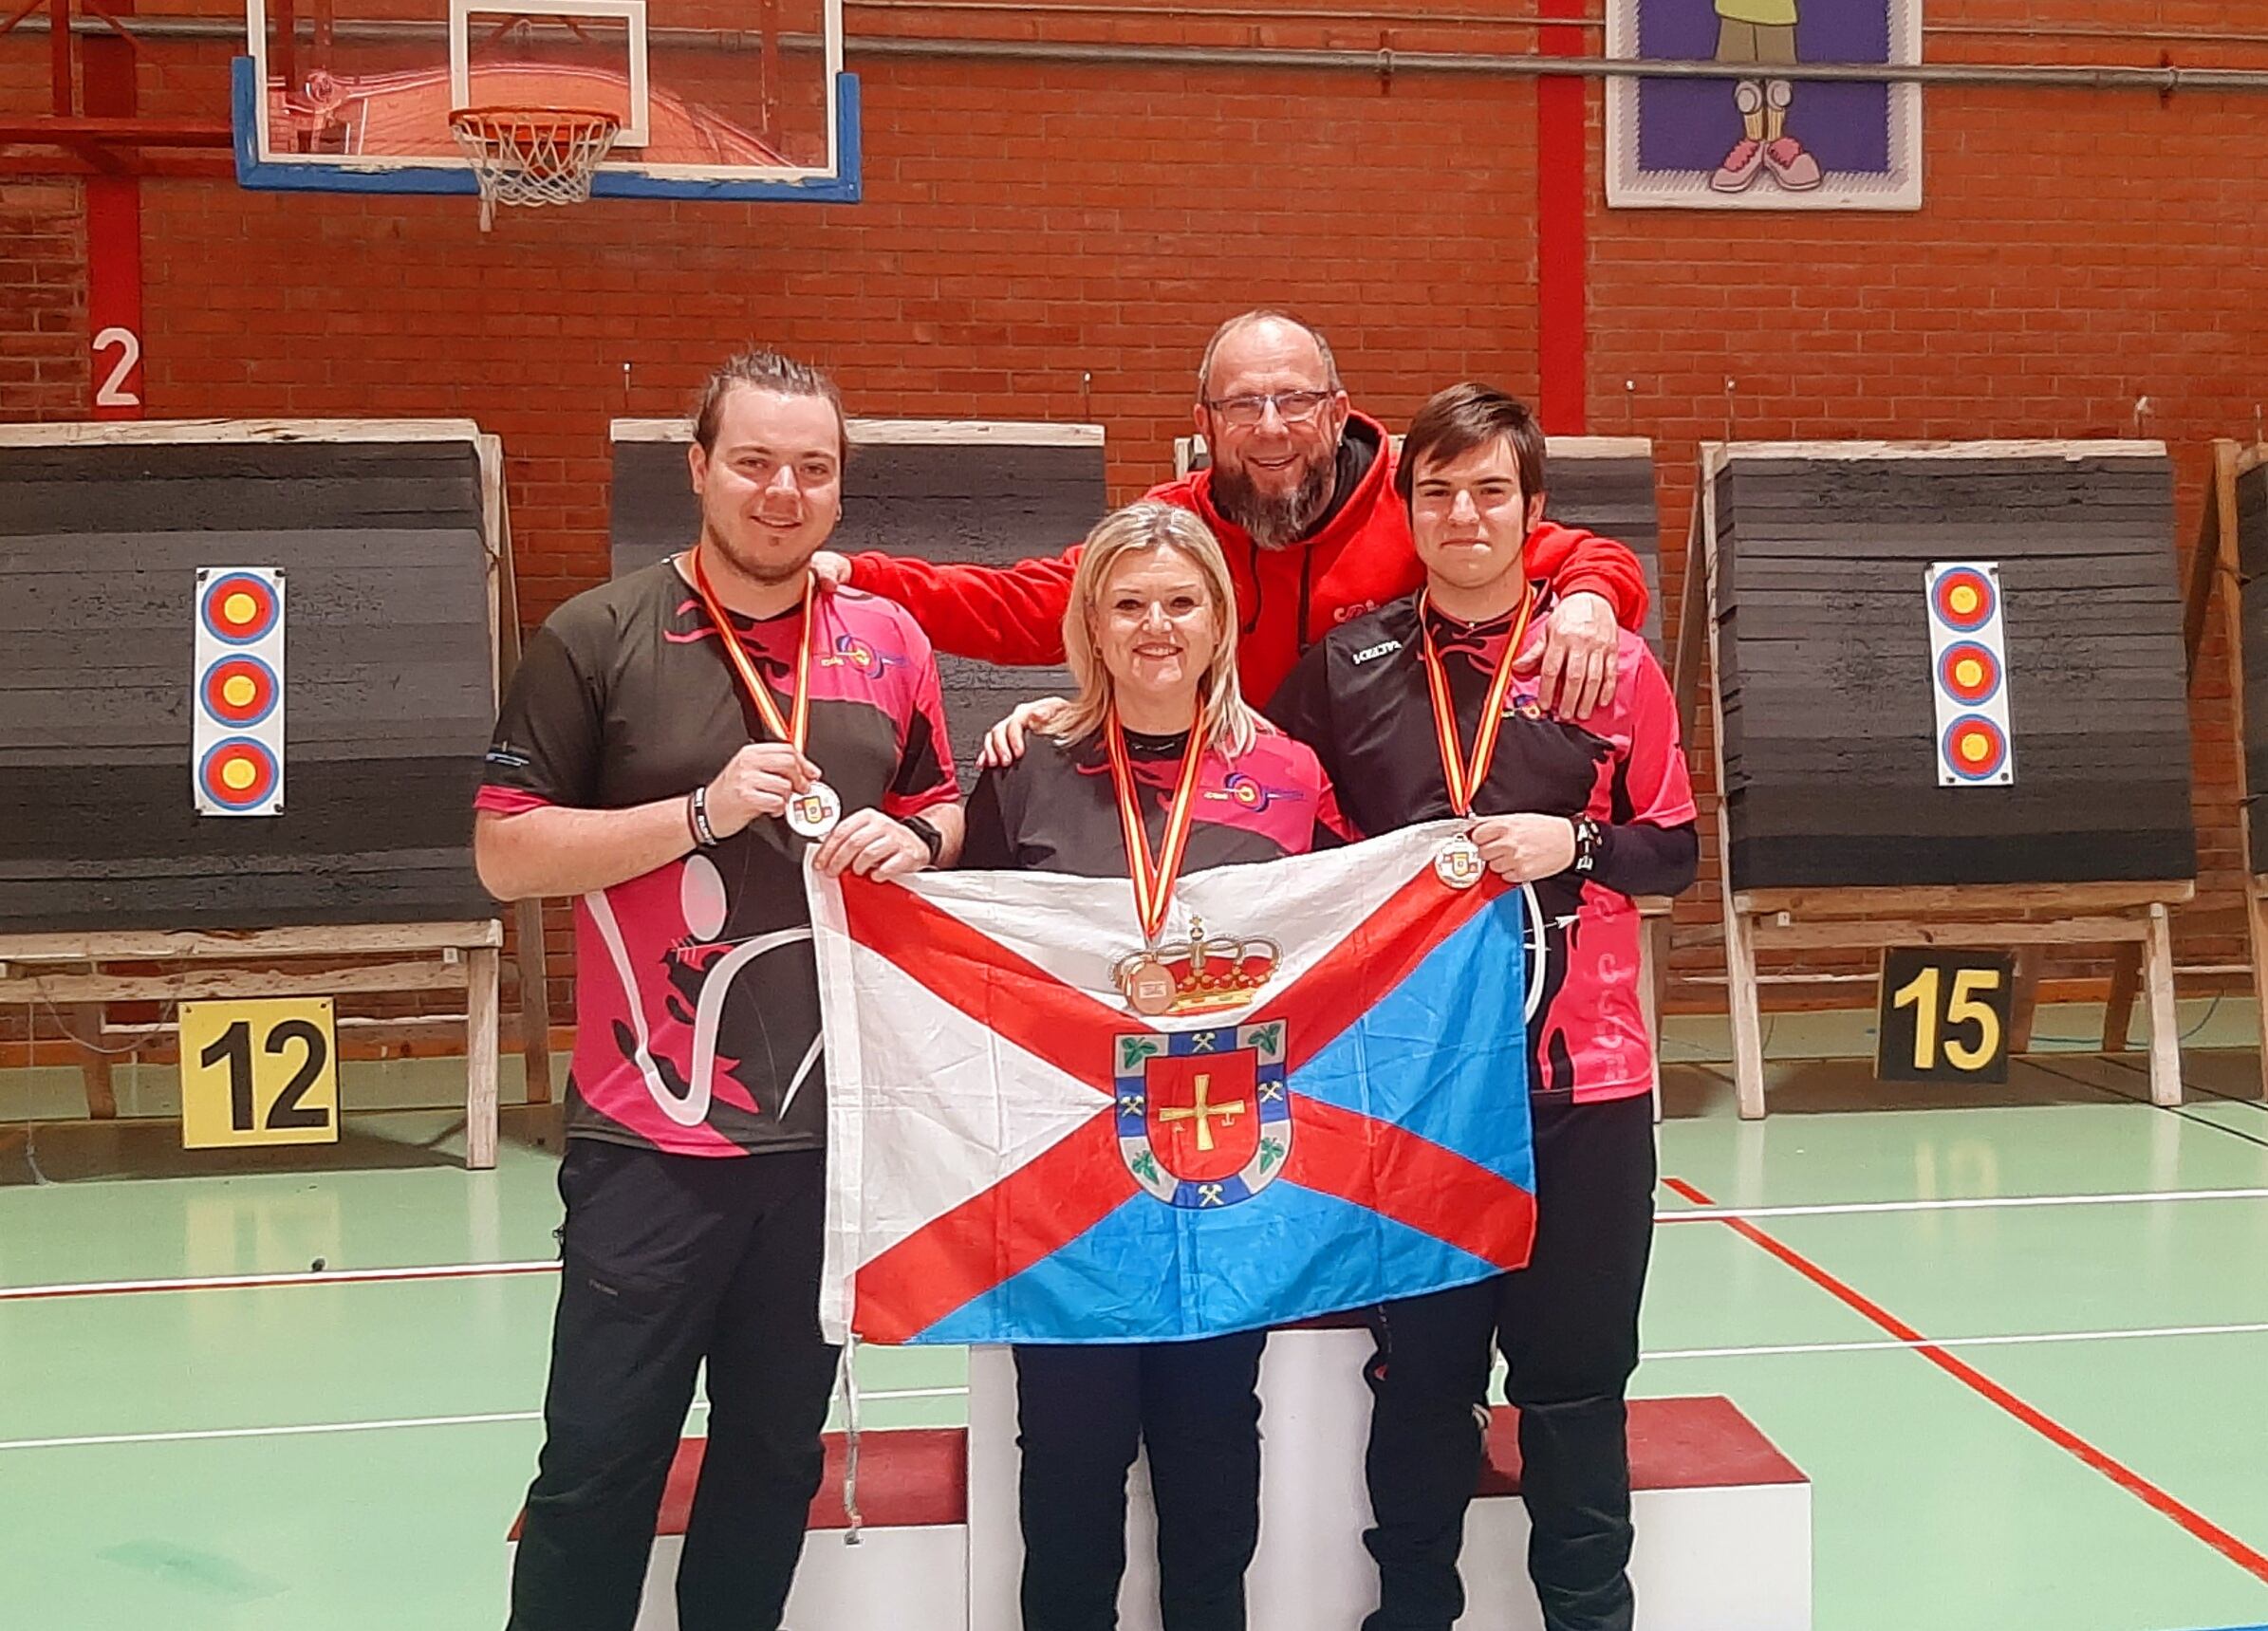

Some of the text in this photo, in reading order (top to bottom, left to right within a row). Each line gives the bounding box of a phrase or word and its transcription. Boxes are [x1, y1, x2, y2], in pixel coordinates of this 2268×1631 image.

[92, 326, 139, 406] 2
[1893, 967, 2000, 1071] 15
[200, 1019, 330, 1132] 12
